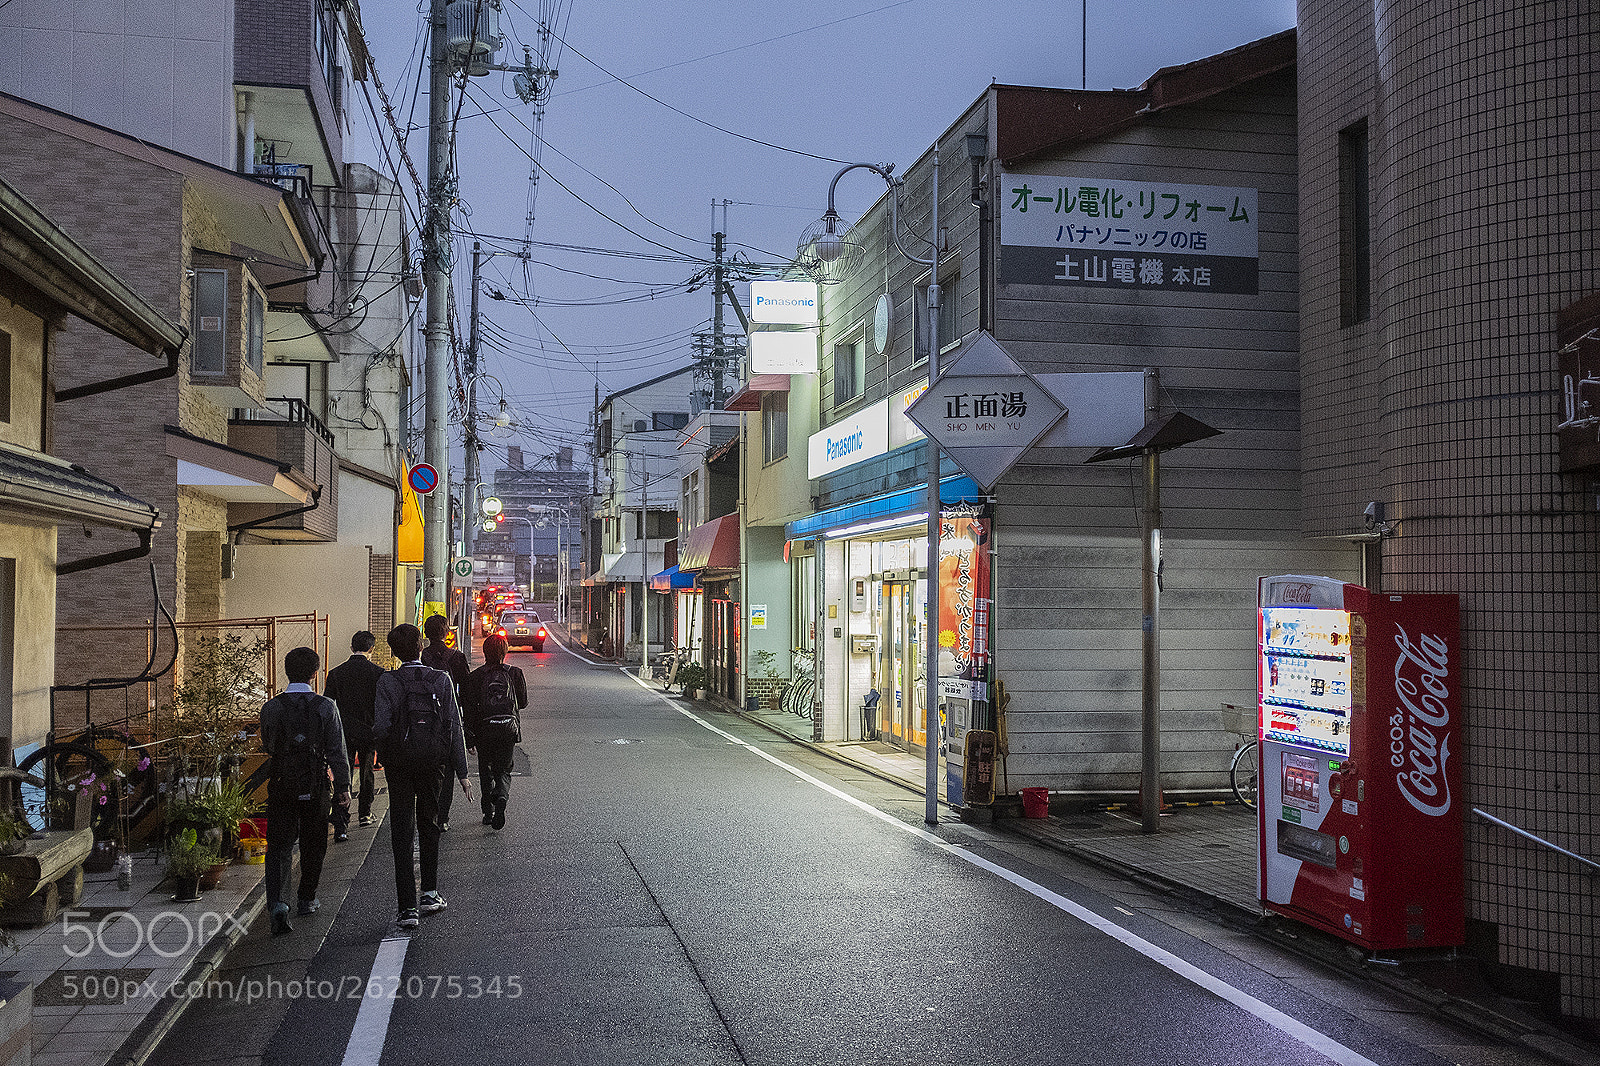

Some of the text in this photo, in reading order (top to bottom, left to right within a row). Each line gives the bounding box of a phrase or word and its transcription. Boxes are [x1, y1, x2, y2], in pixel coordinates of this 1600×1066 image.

[1011, 183, 1250, 224] オール電化・リフォーム
[1055, 223, 1208, 250] パナソニックの店
[1054, 254, 1211, 287] 土山電機 本店
[756, 296, 814, 307] Panasonic
[943, 392, 1028, 418] 正面湯
[946, 422, 1021, 431] SHO MEN YU
[826, 425, 863, 462] Panasonic
[1283, 585, 1312, 603] Coca-Cola
[1394, 622, 1451, 816] Coca-Cola
